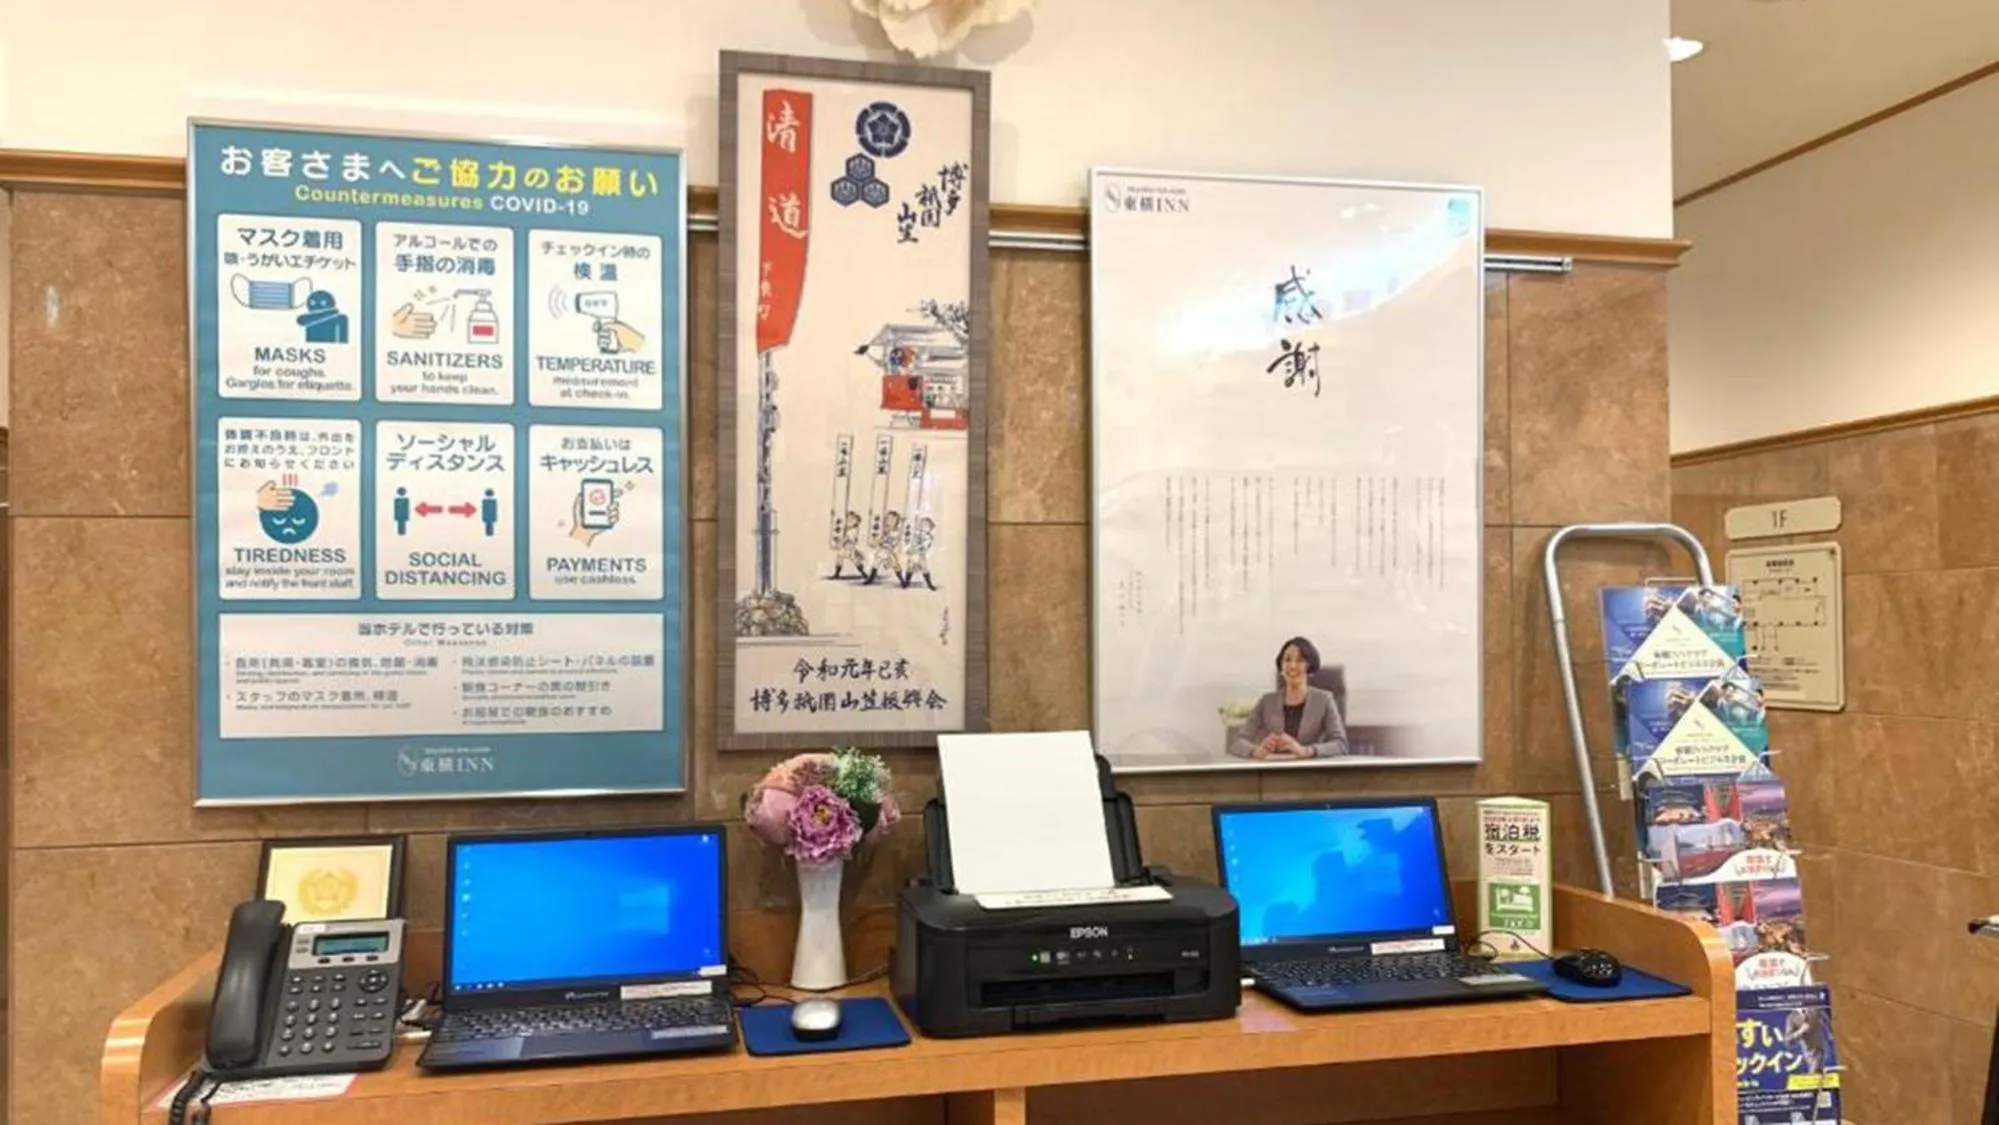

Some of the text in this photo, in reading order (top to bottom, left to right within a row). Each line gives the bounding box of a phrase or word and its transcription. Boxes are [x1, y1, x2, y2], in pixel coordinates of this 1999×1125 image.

[294, 185, 591, 216] Countermeasures COVID-19
[237, 228, 343, 250] マスク着用
[393, 233, 498, 252] アルコールでの
[541, 241, 651, 260] チェックイン時の
[394, 254, 497, 276] 手指の消毒
[1266, 264, 1323, 397] 感謝
[254, 348, 326, 363] MASKS
[386, 351, 504, 369] SANITIZERS
[253, 365, 272, 377] for
[536, 356, 657, 375] TEMPERATURE
[277, 378, 294, 389] for
[422, 371, 468, 384] to keep
[553, 376, 639, 388] measurement
[390, 385, 419, 396] your
[421, 384, 459, 394] hands
[397, 433, 496, 452] ソーシャル
[561, 437, 632, 451] お支払いは
[224, 458, 355, 470] にお知らせください
[385, 452, 506, 473] ディスタンス
[540, 454, 654, 474] キャッシュレス
[1771, 509, 1788, 528] 1F
[234, 547, 347, 563] TIREDNESS
[408, 552, 482, 567] SOCIAL
[294, 568, 320, 578] your
[546, 557, 647, 573] PAYMENTS
[384, 570, 507, 587] DISTANCING
[554, 576, 577, 586] use
[358, 621, 534, 637] 当ホテルで行っている対策
[1484, 823, 1541, 842] 宿泊税
[1484, 842, 1541, 857] をスタート
[1069, 926, 1108, 940] EPSON
